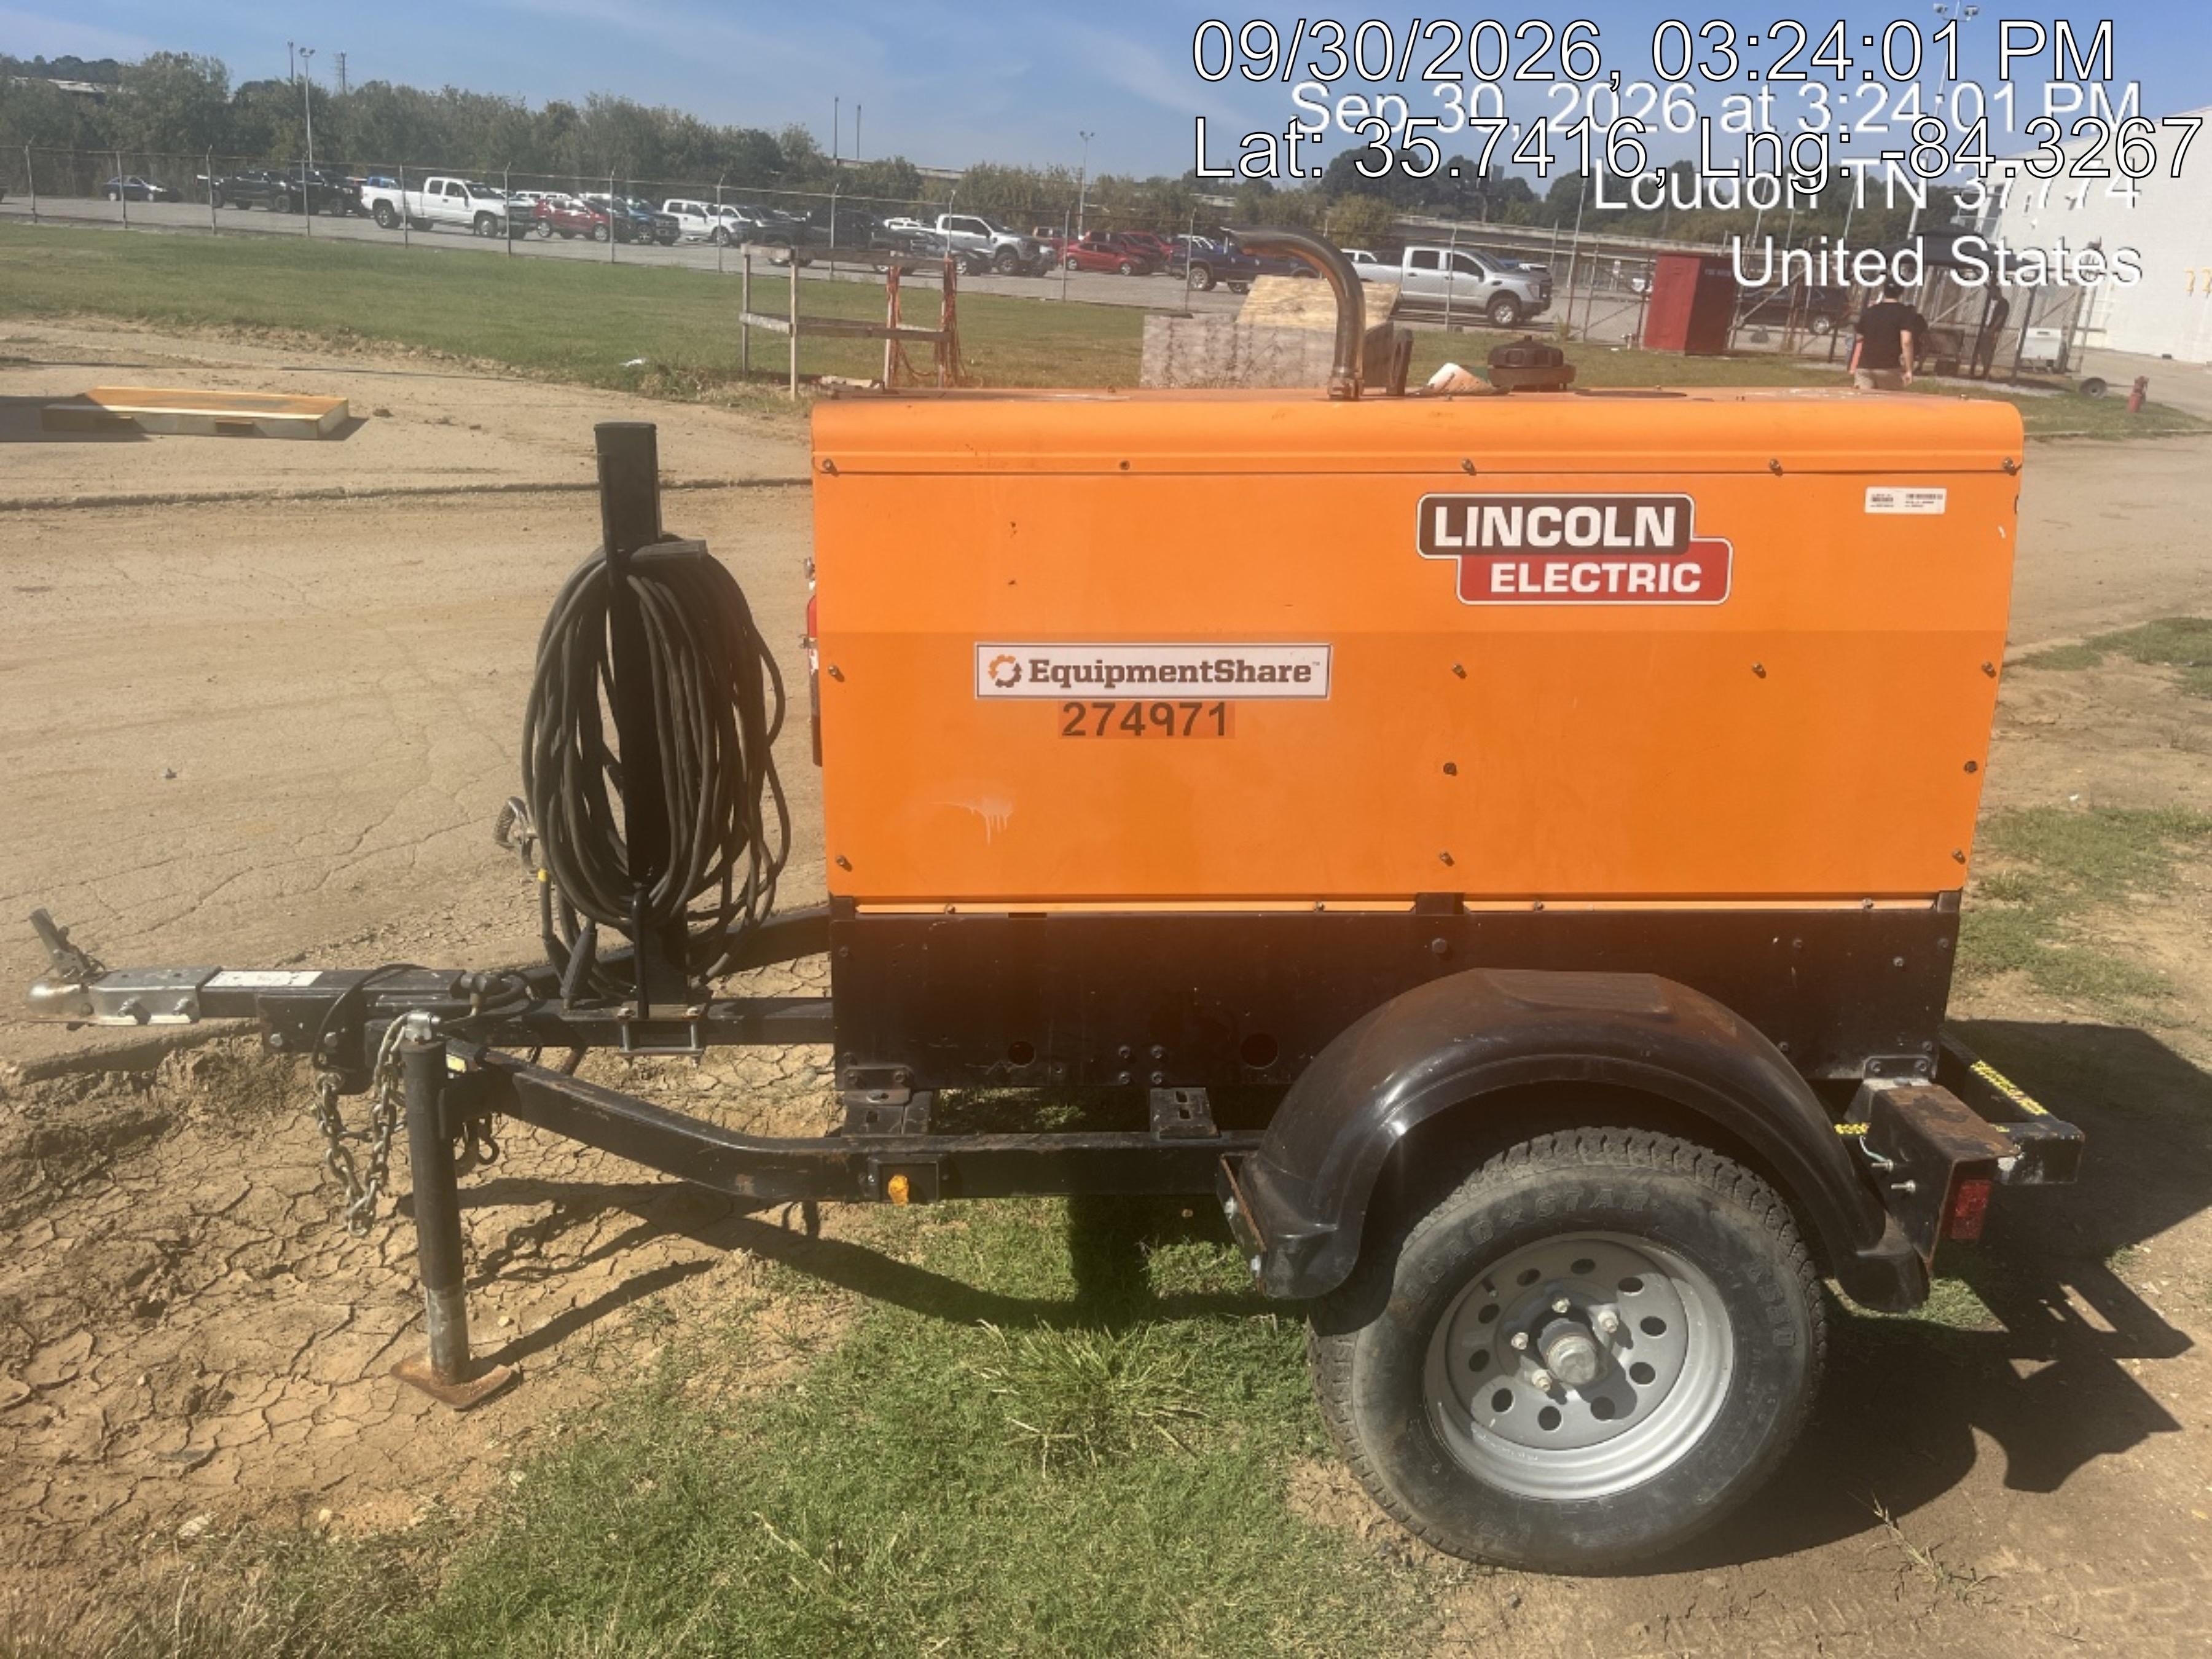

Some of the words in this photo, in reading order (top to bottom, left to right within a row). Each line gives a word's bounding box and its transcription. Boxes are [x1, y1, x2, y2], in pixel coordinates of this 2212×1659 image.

[1433, 506, 1676, 547] LINCOLN
[1491, 563, 1702, 593] ELECTRIC
[1029, 659, 1311, 688] EquipmentShare
[1061, 702, 1226, 737] 274971
